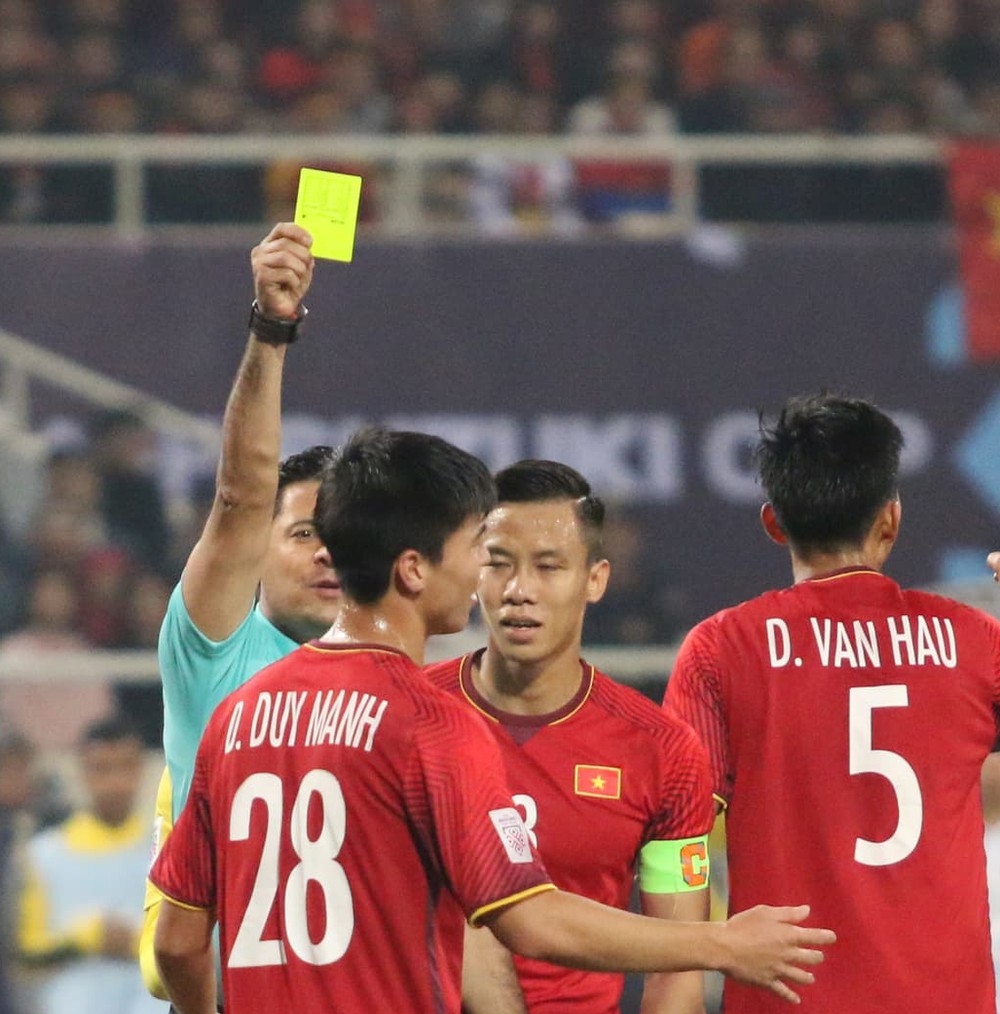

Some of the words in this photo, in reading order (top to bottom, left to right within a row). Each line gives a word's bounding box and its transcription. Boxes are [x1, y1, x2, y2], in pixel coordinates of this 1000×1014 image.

[765, 617, 804, 668] D.
[810, 616, 882, 668] VAN
[886, 614, 958, 669] HAU
[249, 690, 308, 748] DUY
[304, 689, 389, 752] MANH
[848, 684, 924, 867] 5
[227, 768, 355, 968] 28
[680, 842, 707, 887] C
